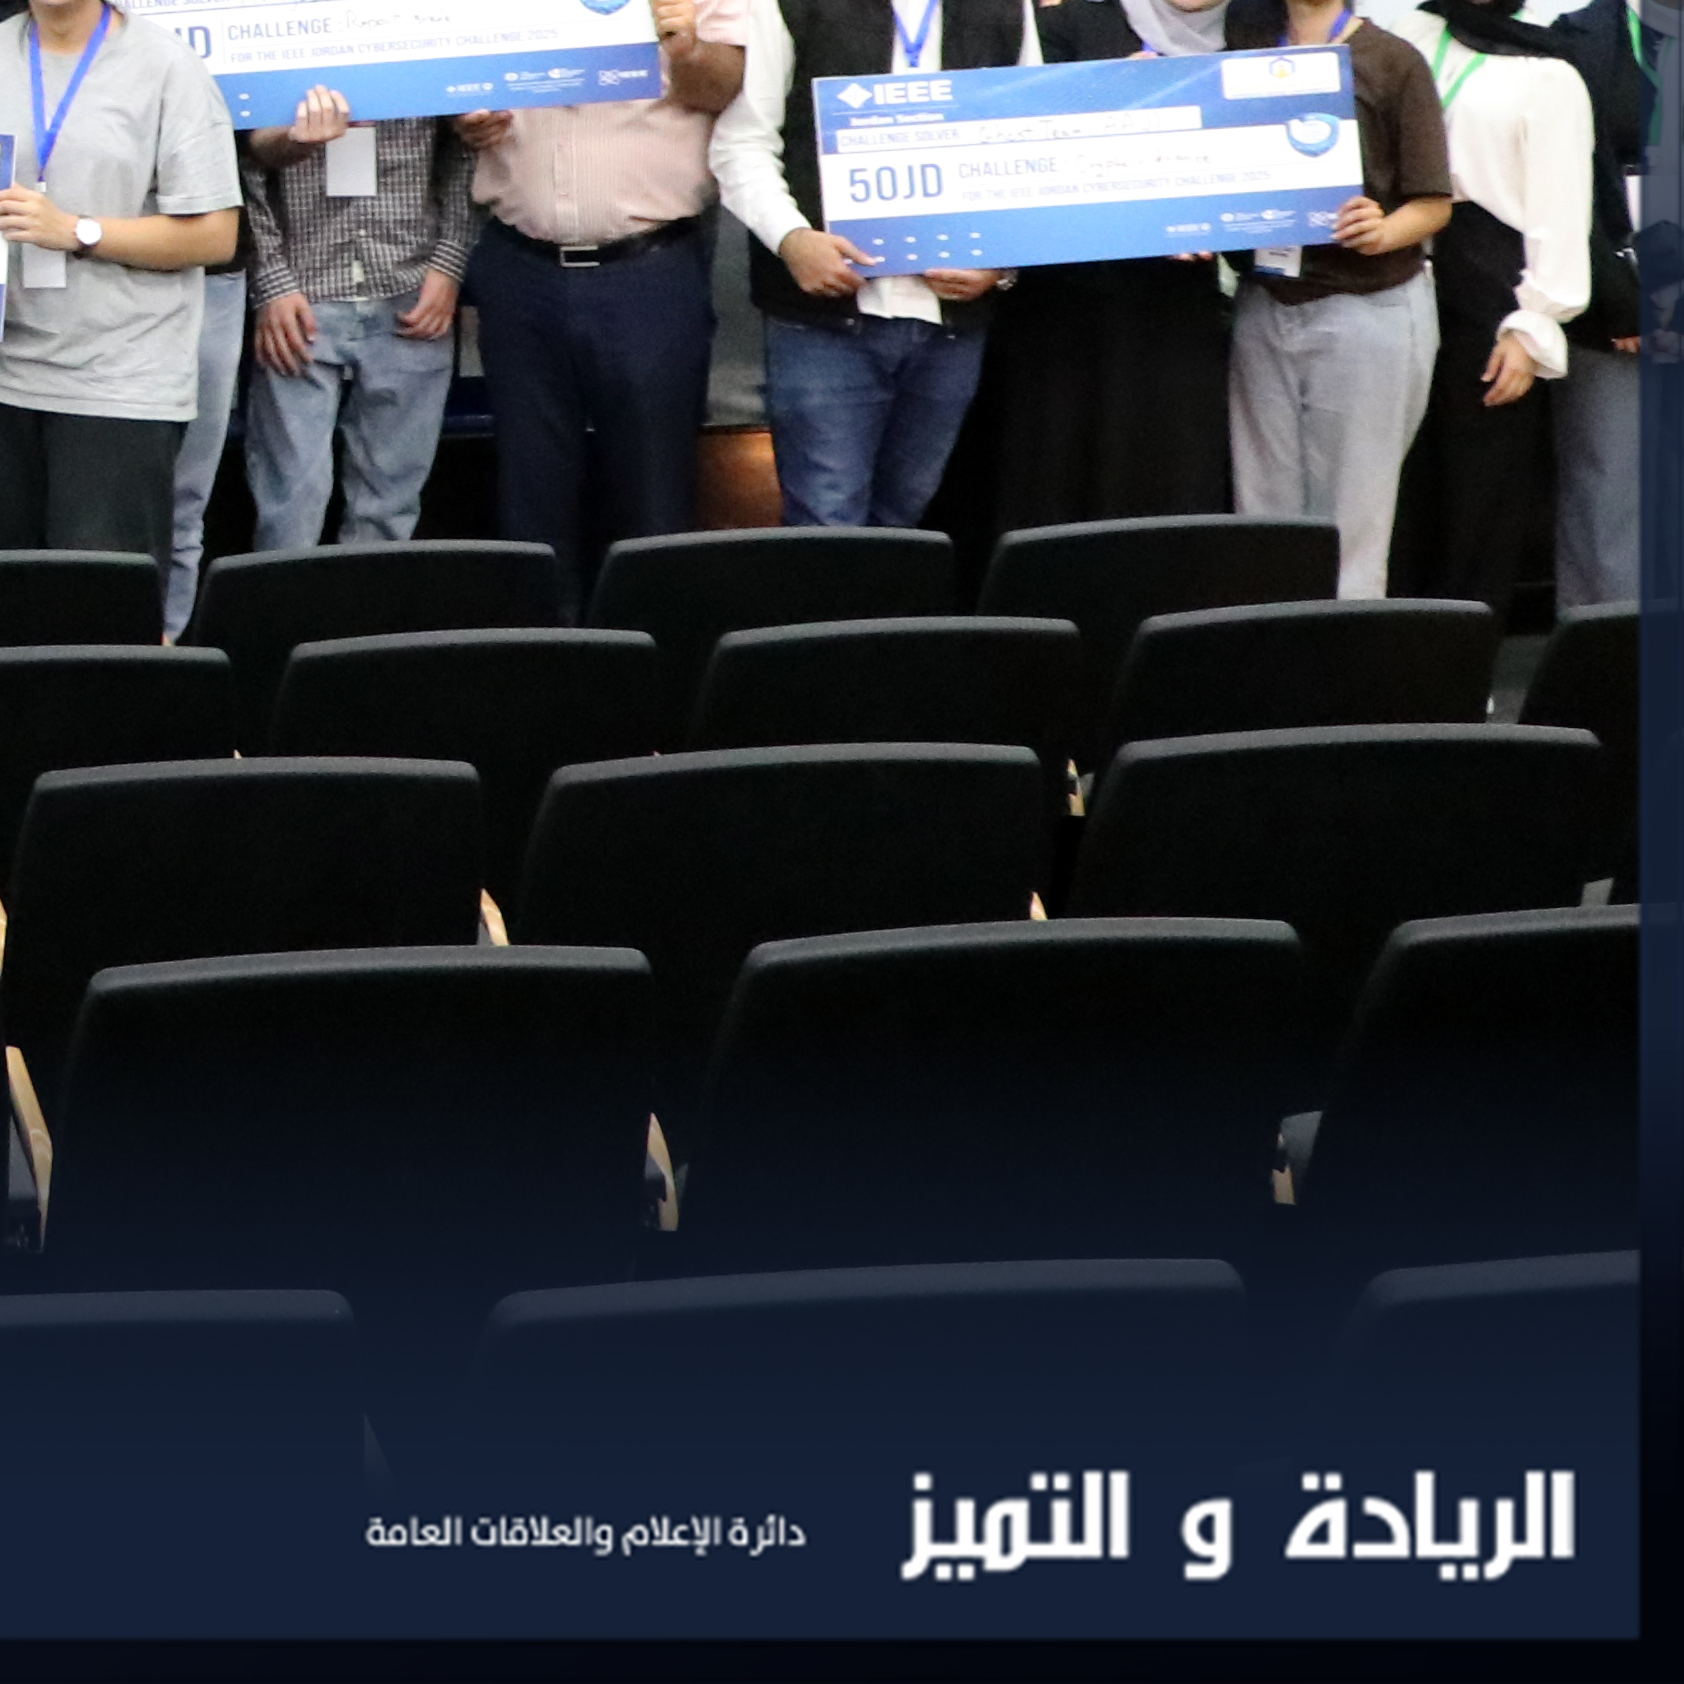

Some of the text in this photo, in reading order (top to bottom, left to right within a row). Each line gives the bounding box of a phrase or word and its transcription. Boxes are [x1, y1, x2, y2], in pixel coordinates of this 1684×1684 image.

[227, 17, 332, 42] CHALLENGE
[873, 78, 953, 106] IEEE
[840, 129, 960, 148] CHALLENGE SOLVER
[958, 157, 1059, 179] CHALLENGE
[847, 162, 944, 204] 50JD
